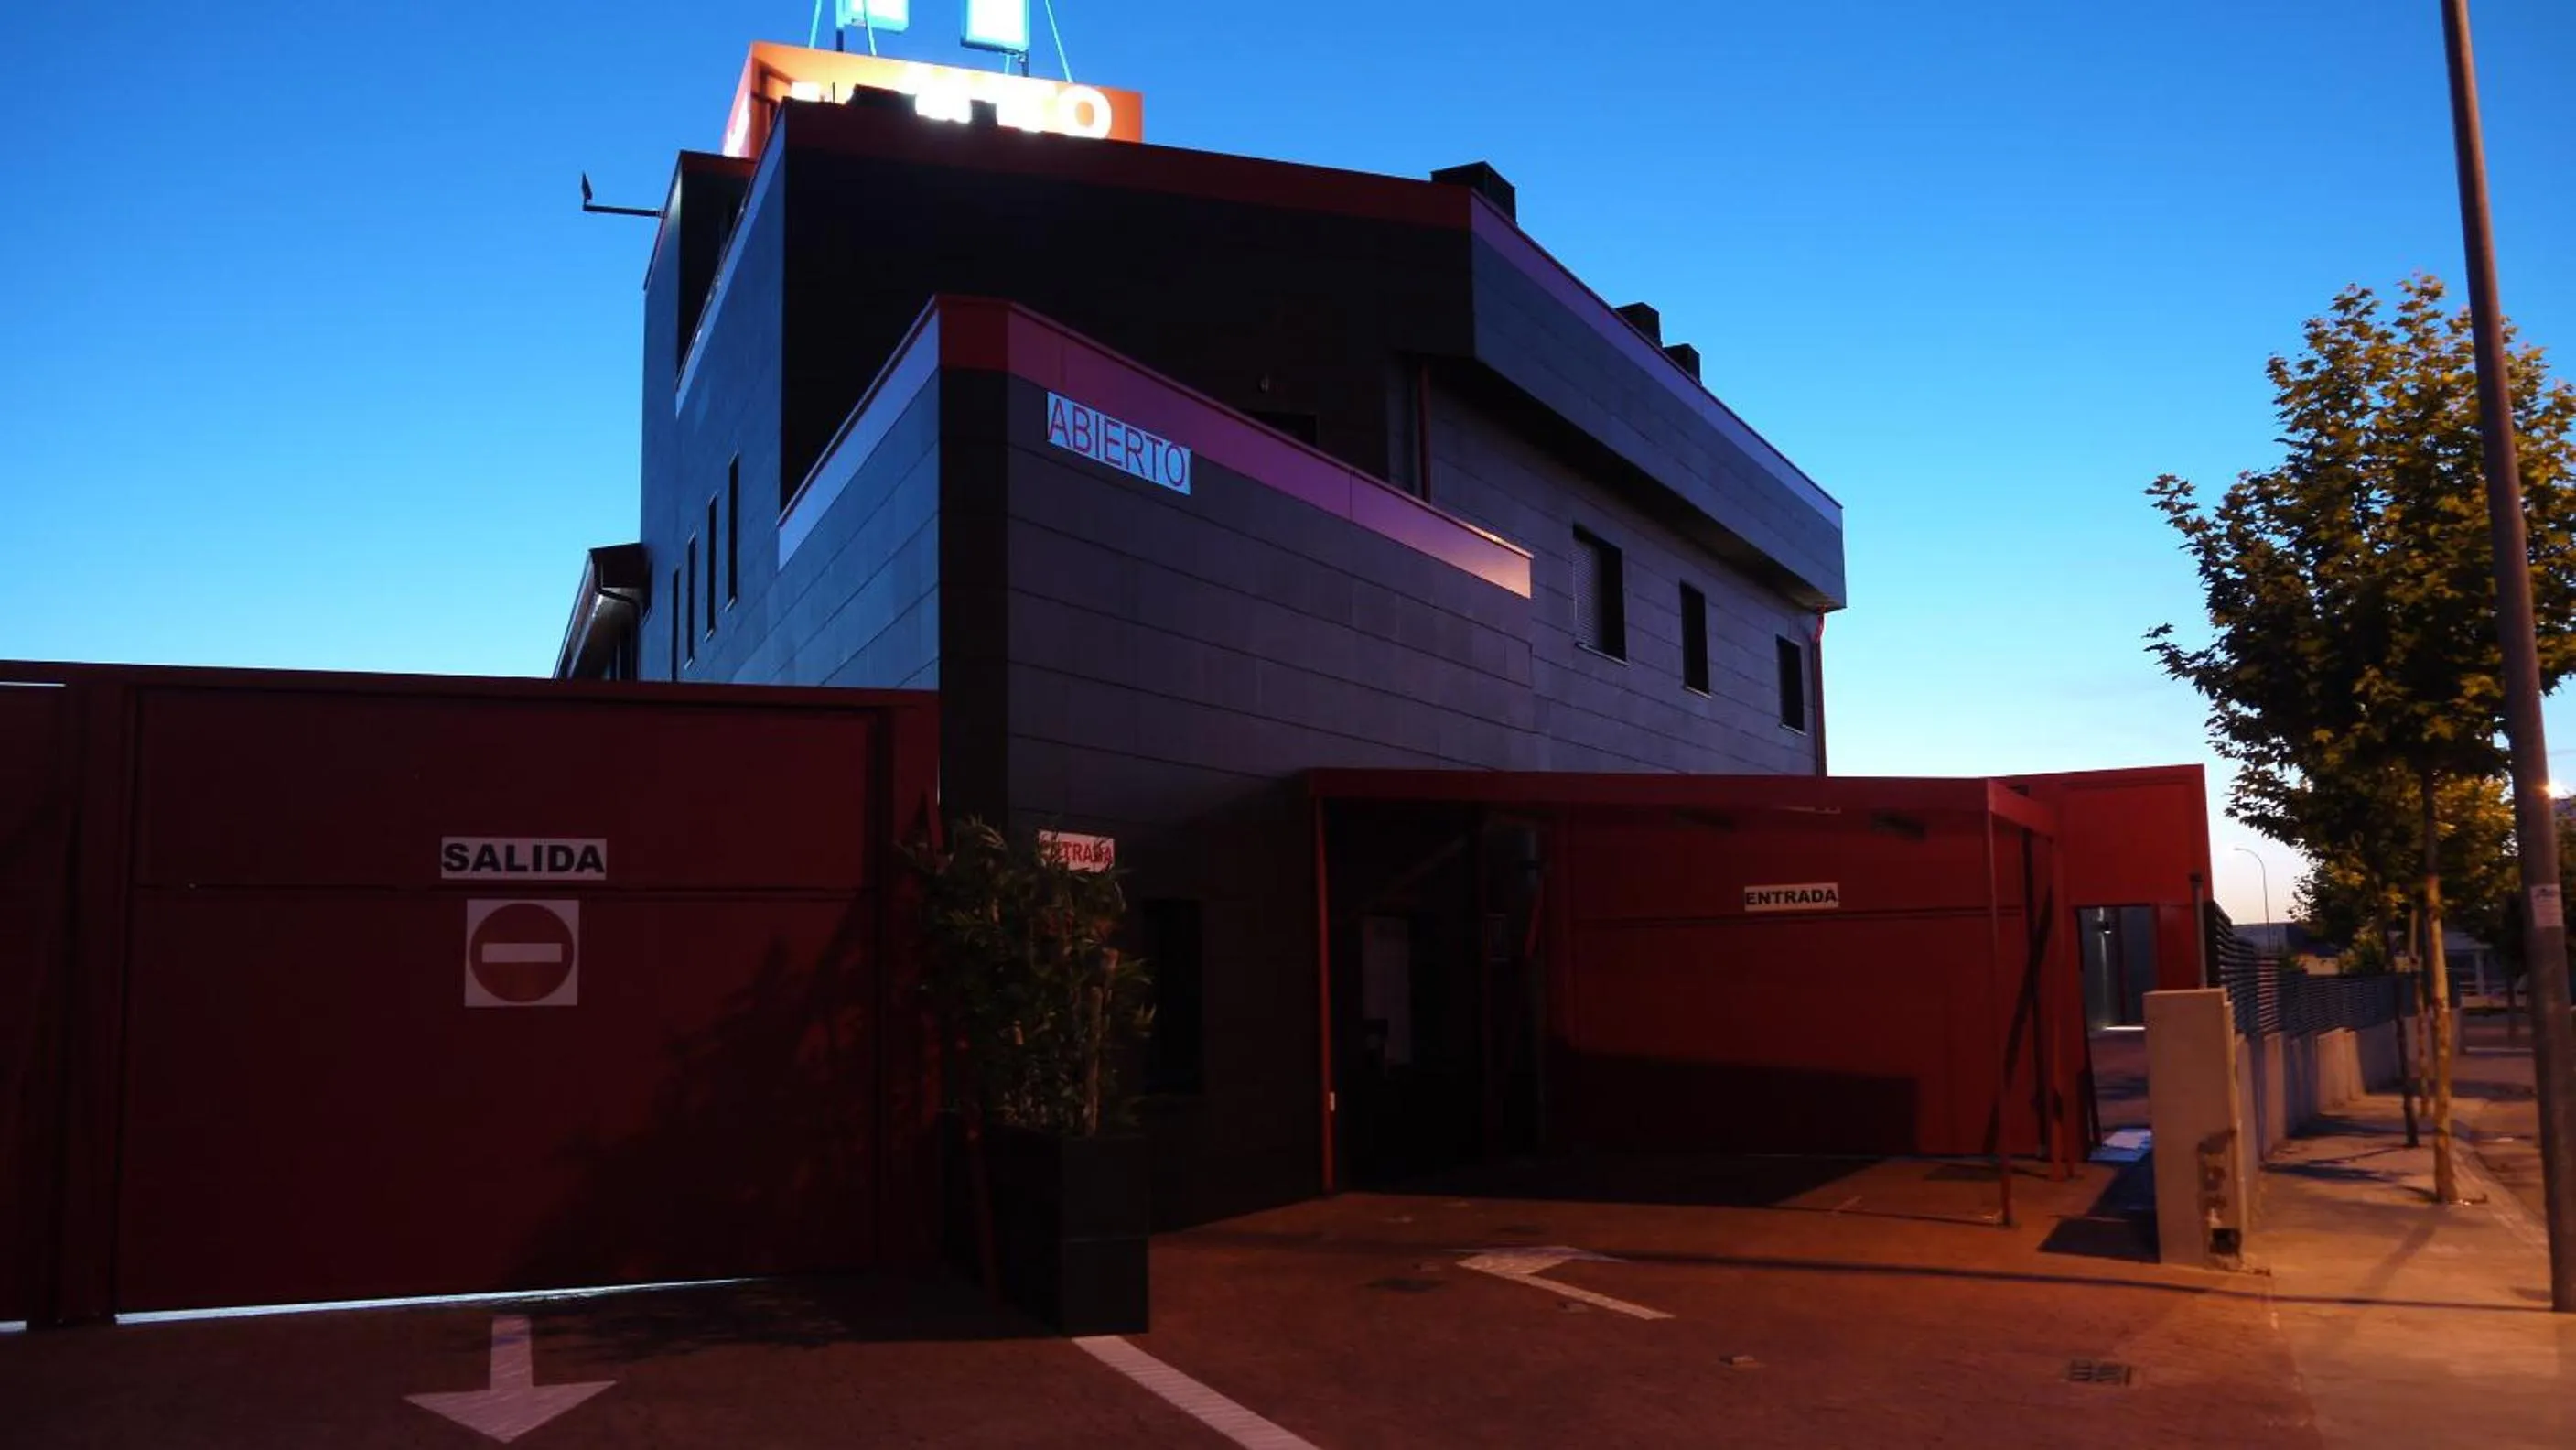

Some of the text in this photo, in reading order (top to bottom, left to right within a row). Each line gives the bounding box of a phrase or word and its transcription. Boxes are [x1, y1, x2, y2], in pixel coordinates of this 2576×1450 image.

[1048, 398, 1185, 486] ABIERTO
[443, 843, 605, 872] SALIDA
[1746, 889, 1837, 904] ENTRADA
